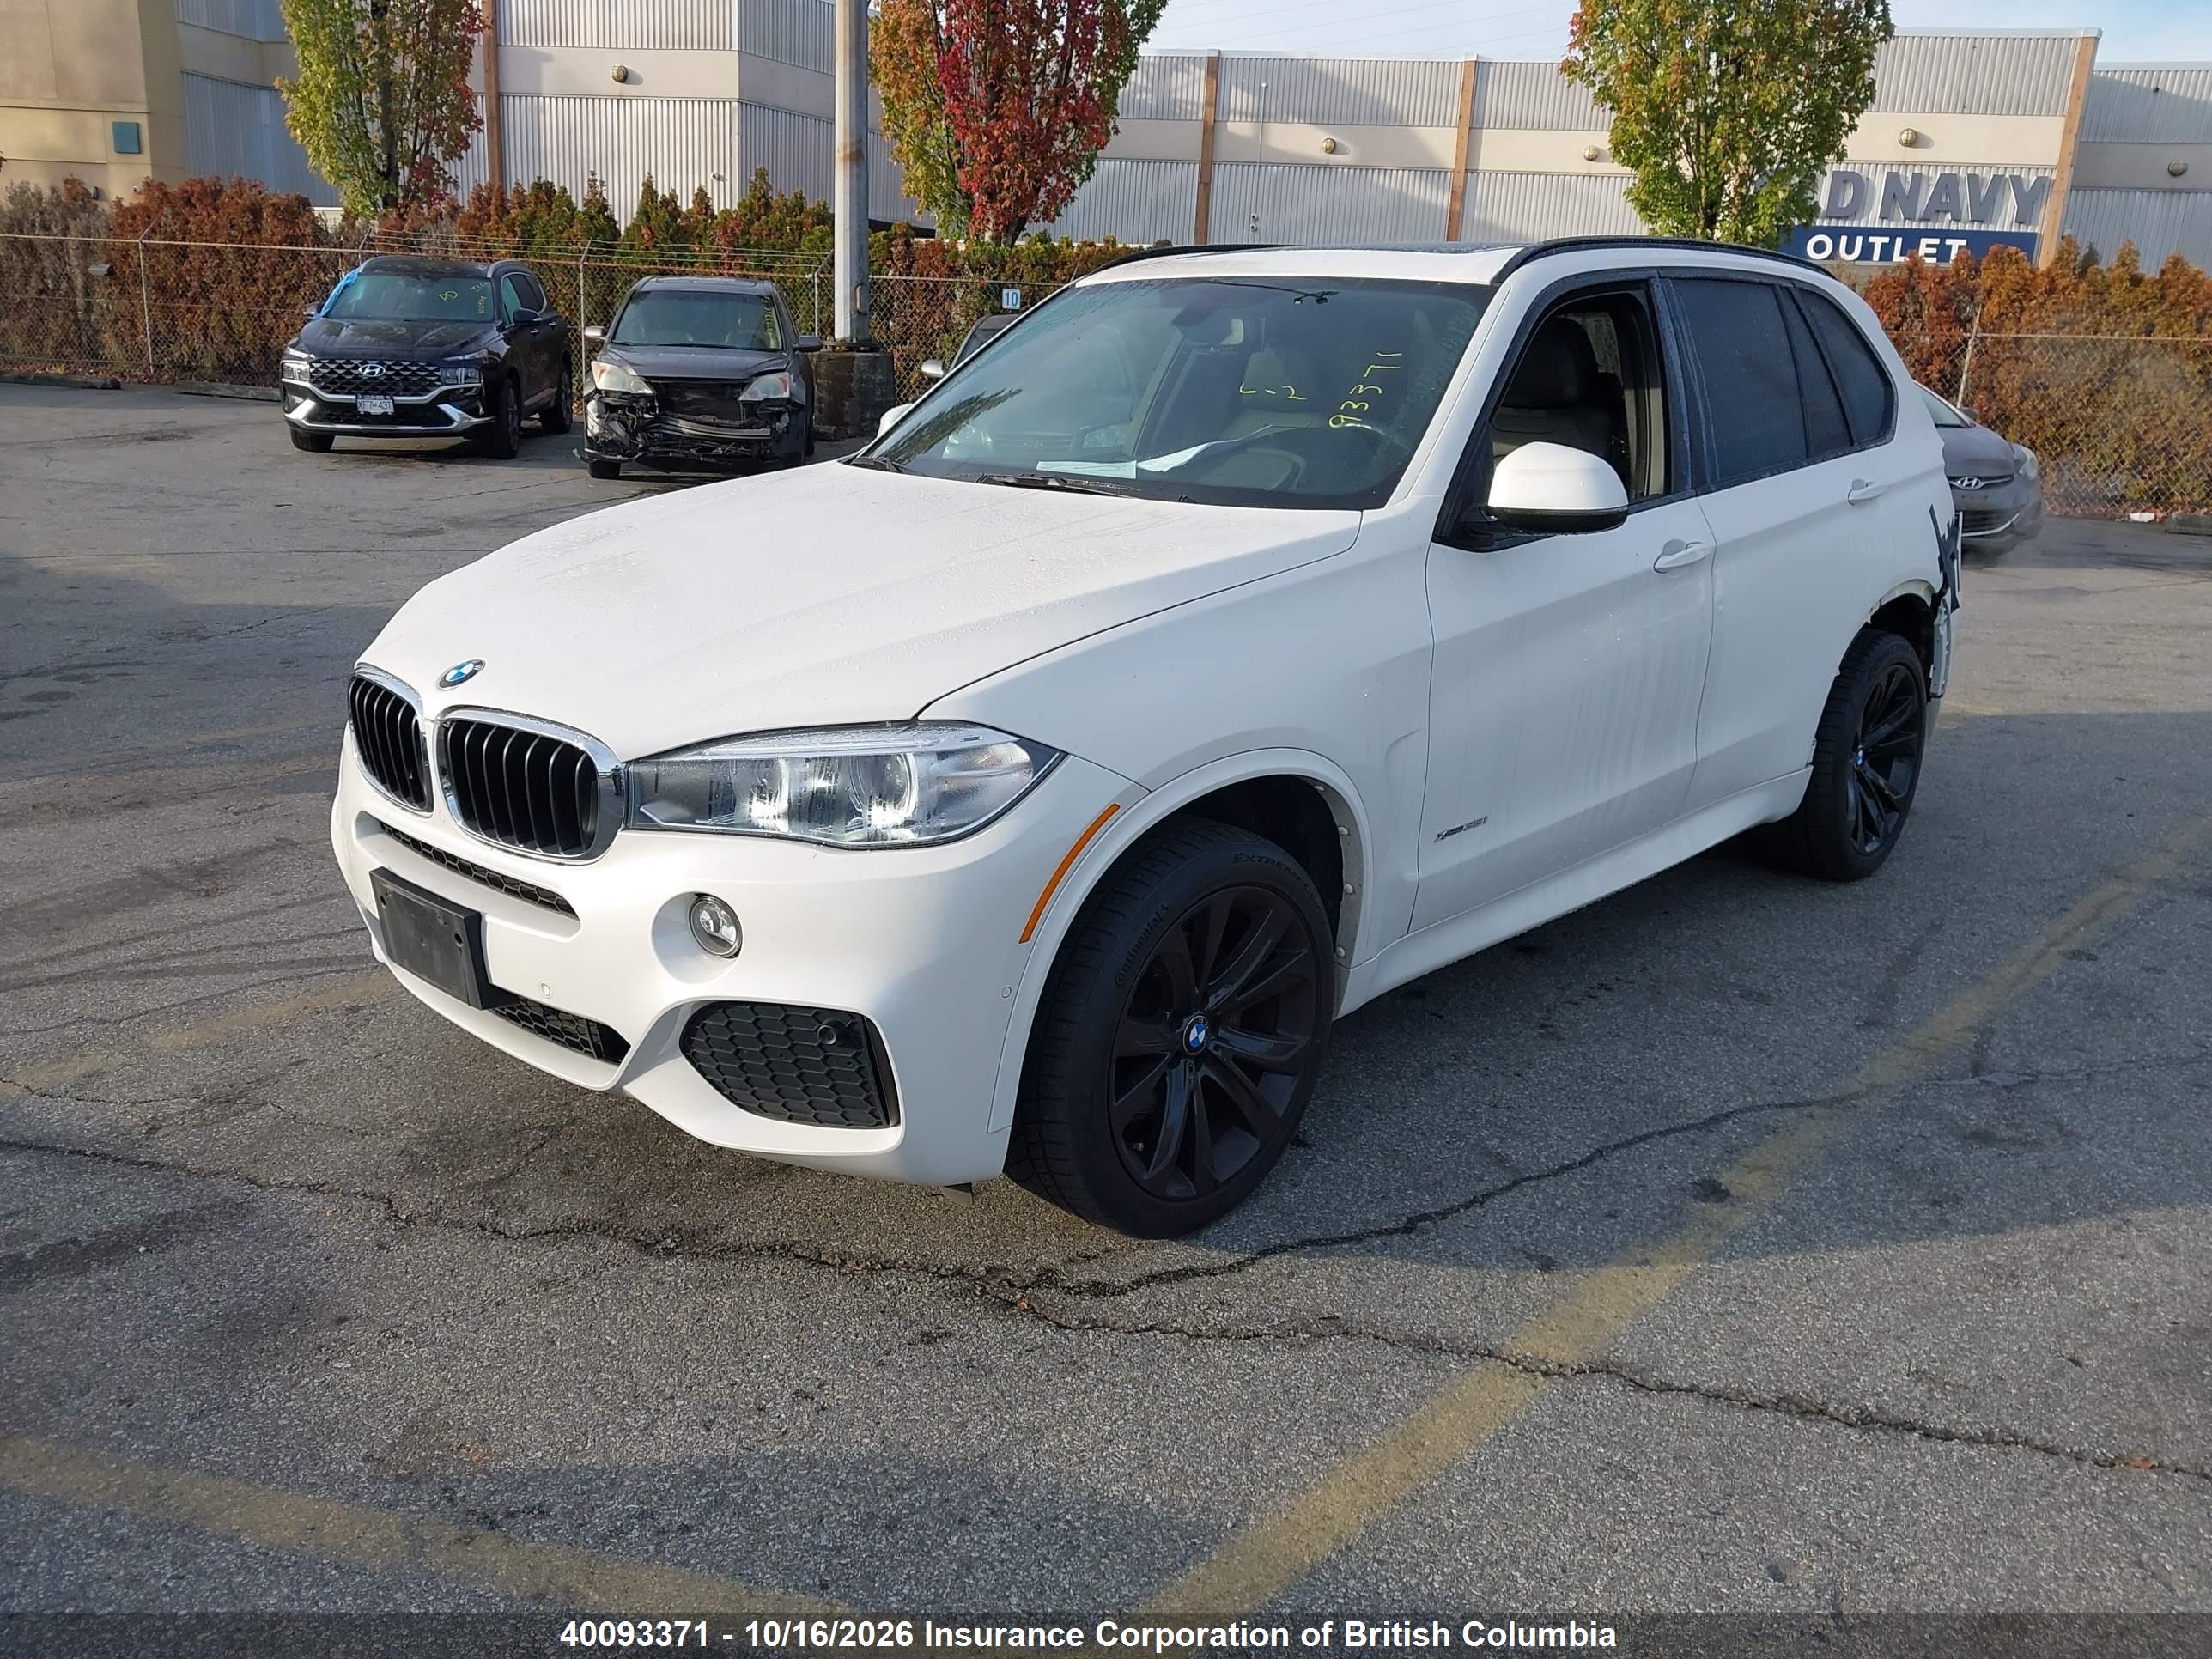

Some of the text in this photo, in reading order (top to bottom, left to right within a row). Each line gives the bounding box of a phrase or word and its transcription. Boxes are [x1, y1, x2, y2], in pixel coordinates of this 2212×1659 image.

[1880, 171, 2051, 223] NAVY
[1806, 234, 1967, 264] OUTLET
[1005, 291, 1018, 307] 10
